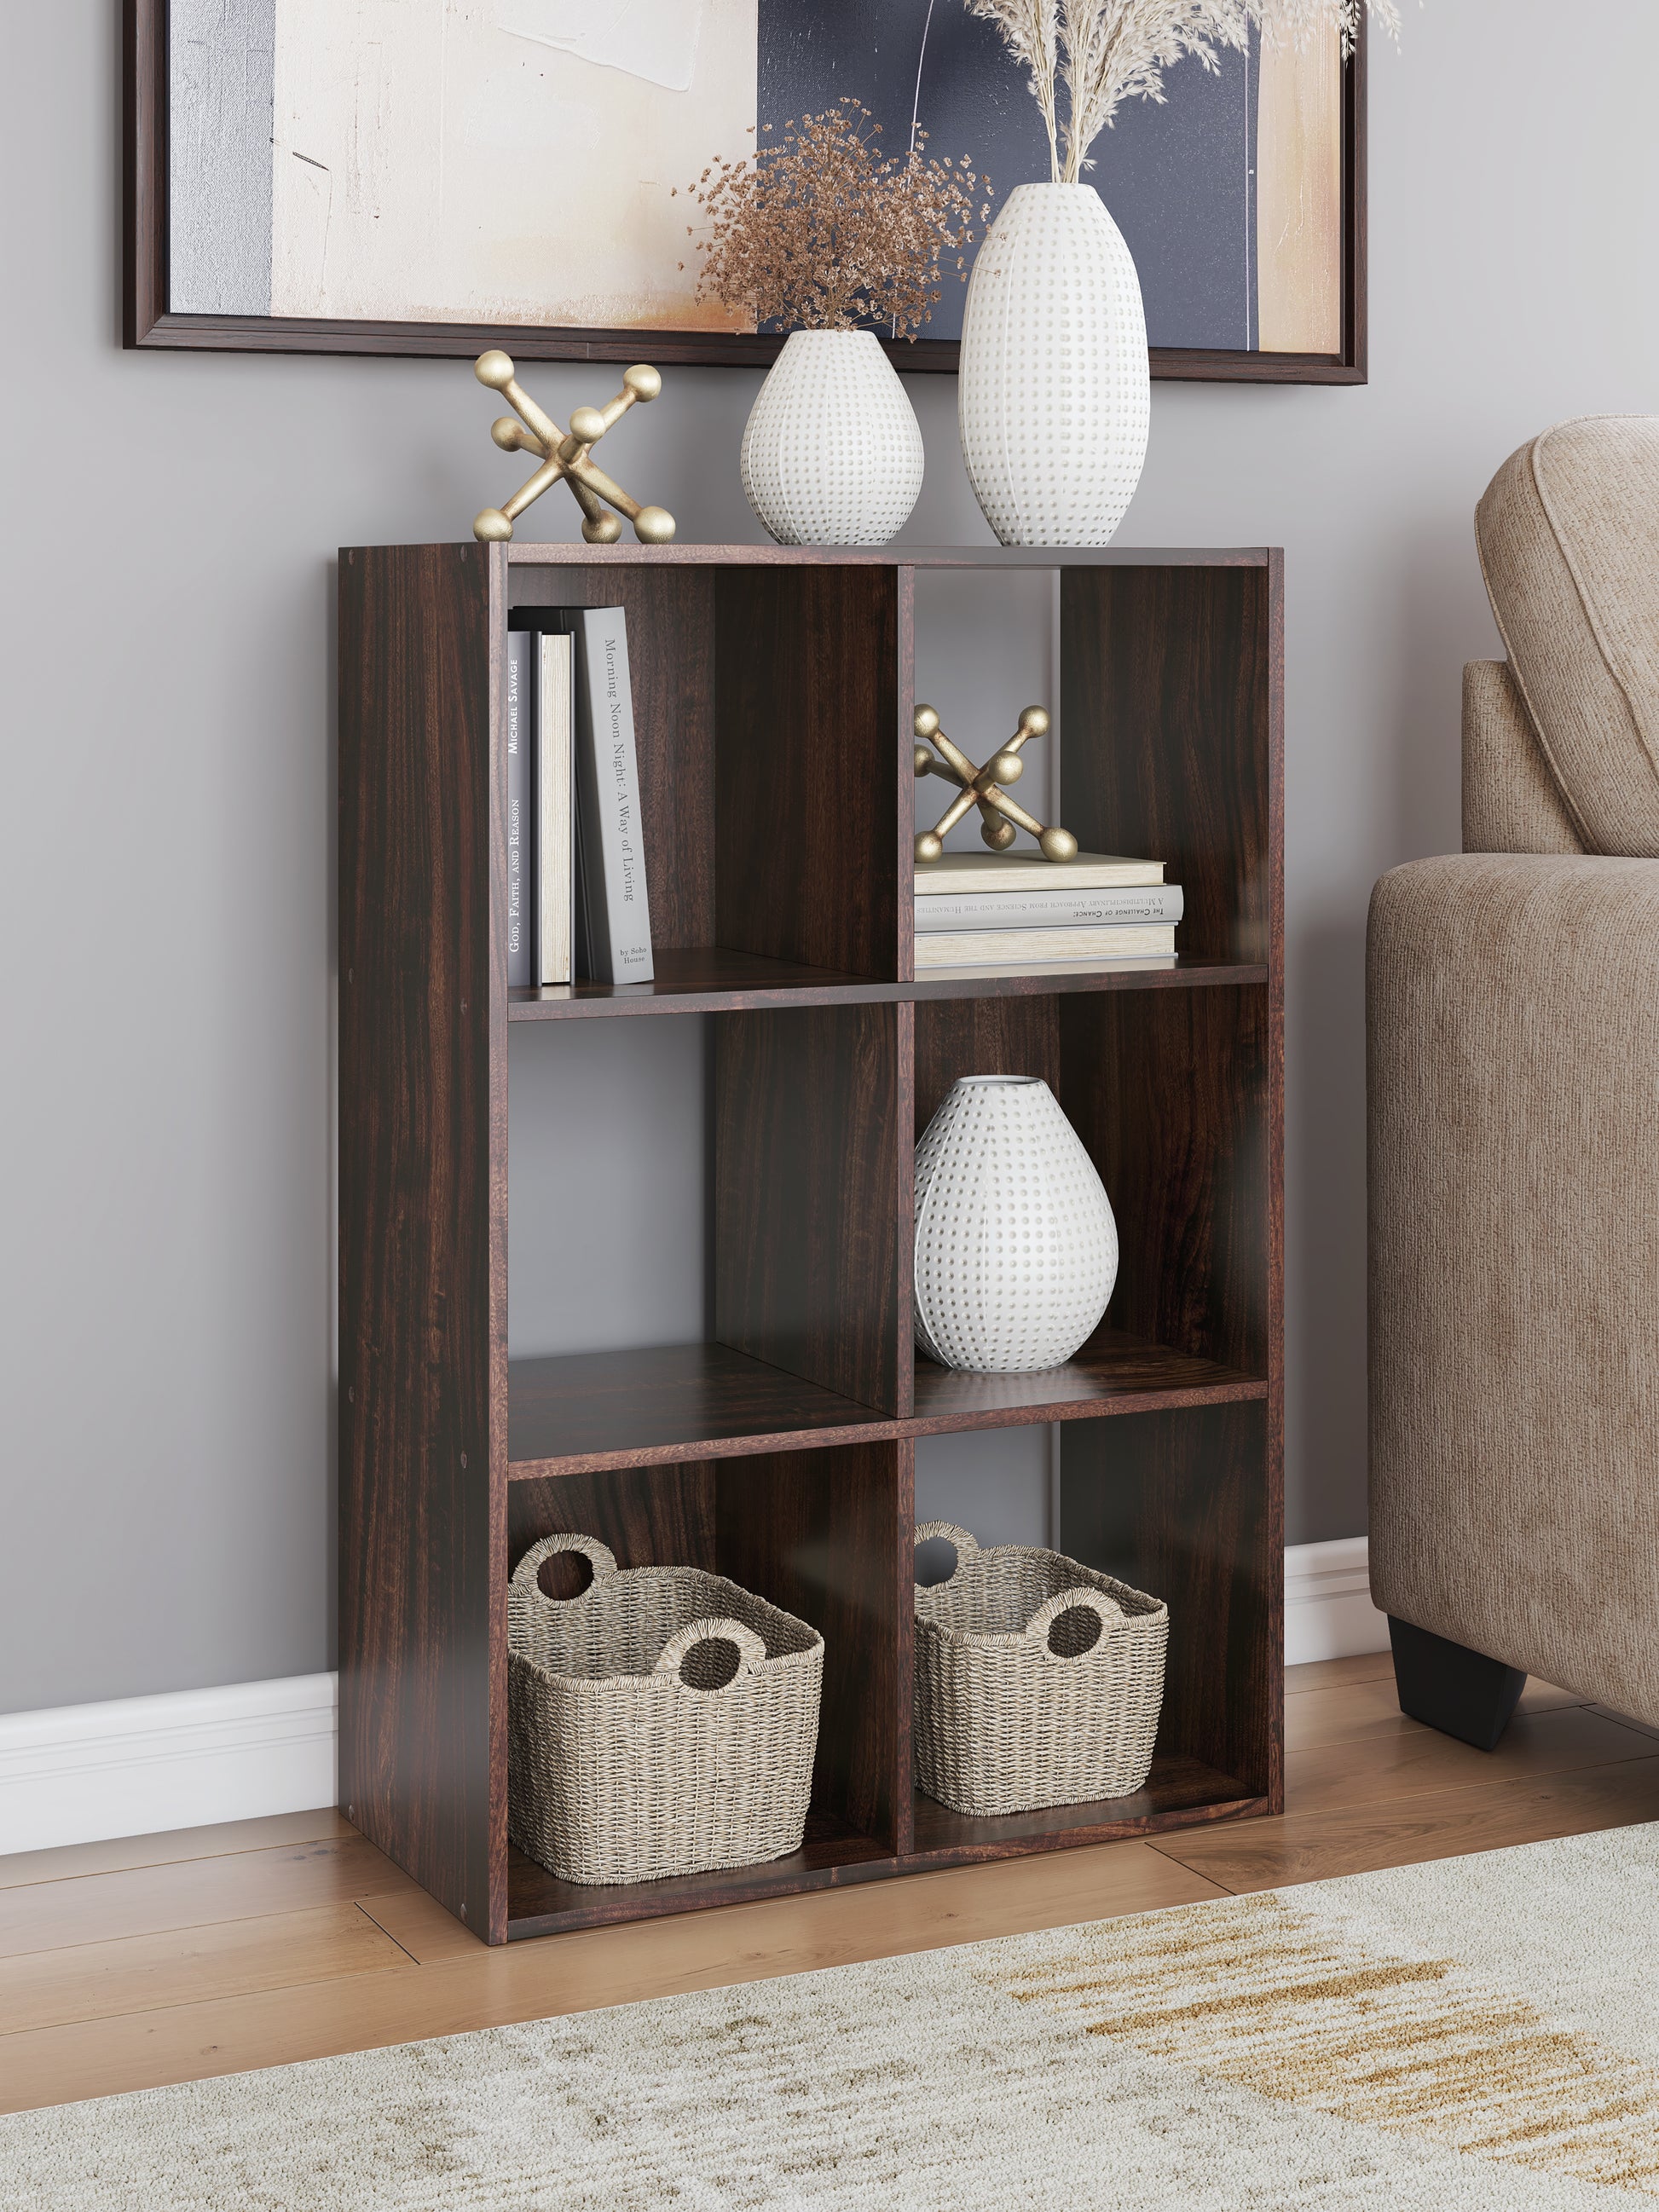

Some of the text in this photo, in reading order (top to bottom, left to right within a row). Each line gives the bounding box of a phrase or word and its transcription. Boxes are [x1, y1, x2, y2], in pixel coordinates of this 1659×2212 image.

[508, 659, 517, 754] MICHAEL SAVAGE
[605, 638, 635, 902] Morning Noon Night: A Way of Living
[510, 800, 519, 846] REASON
[510, 878, 521, 917] FAITH,
[510, 922, 521, 952] GOD,
[631, 947, 647, 956] Soho
